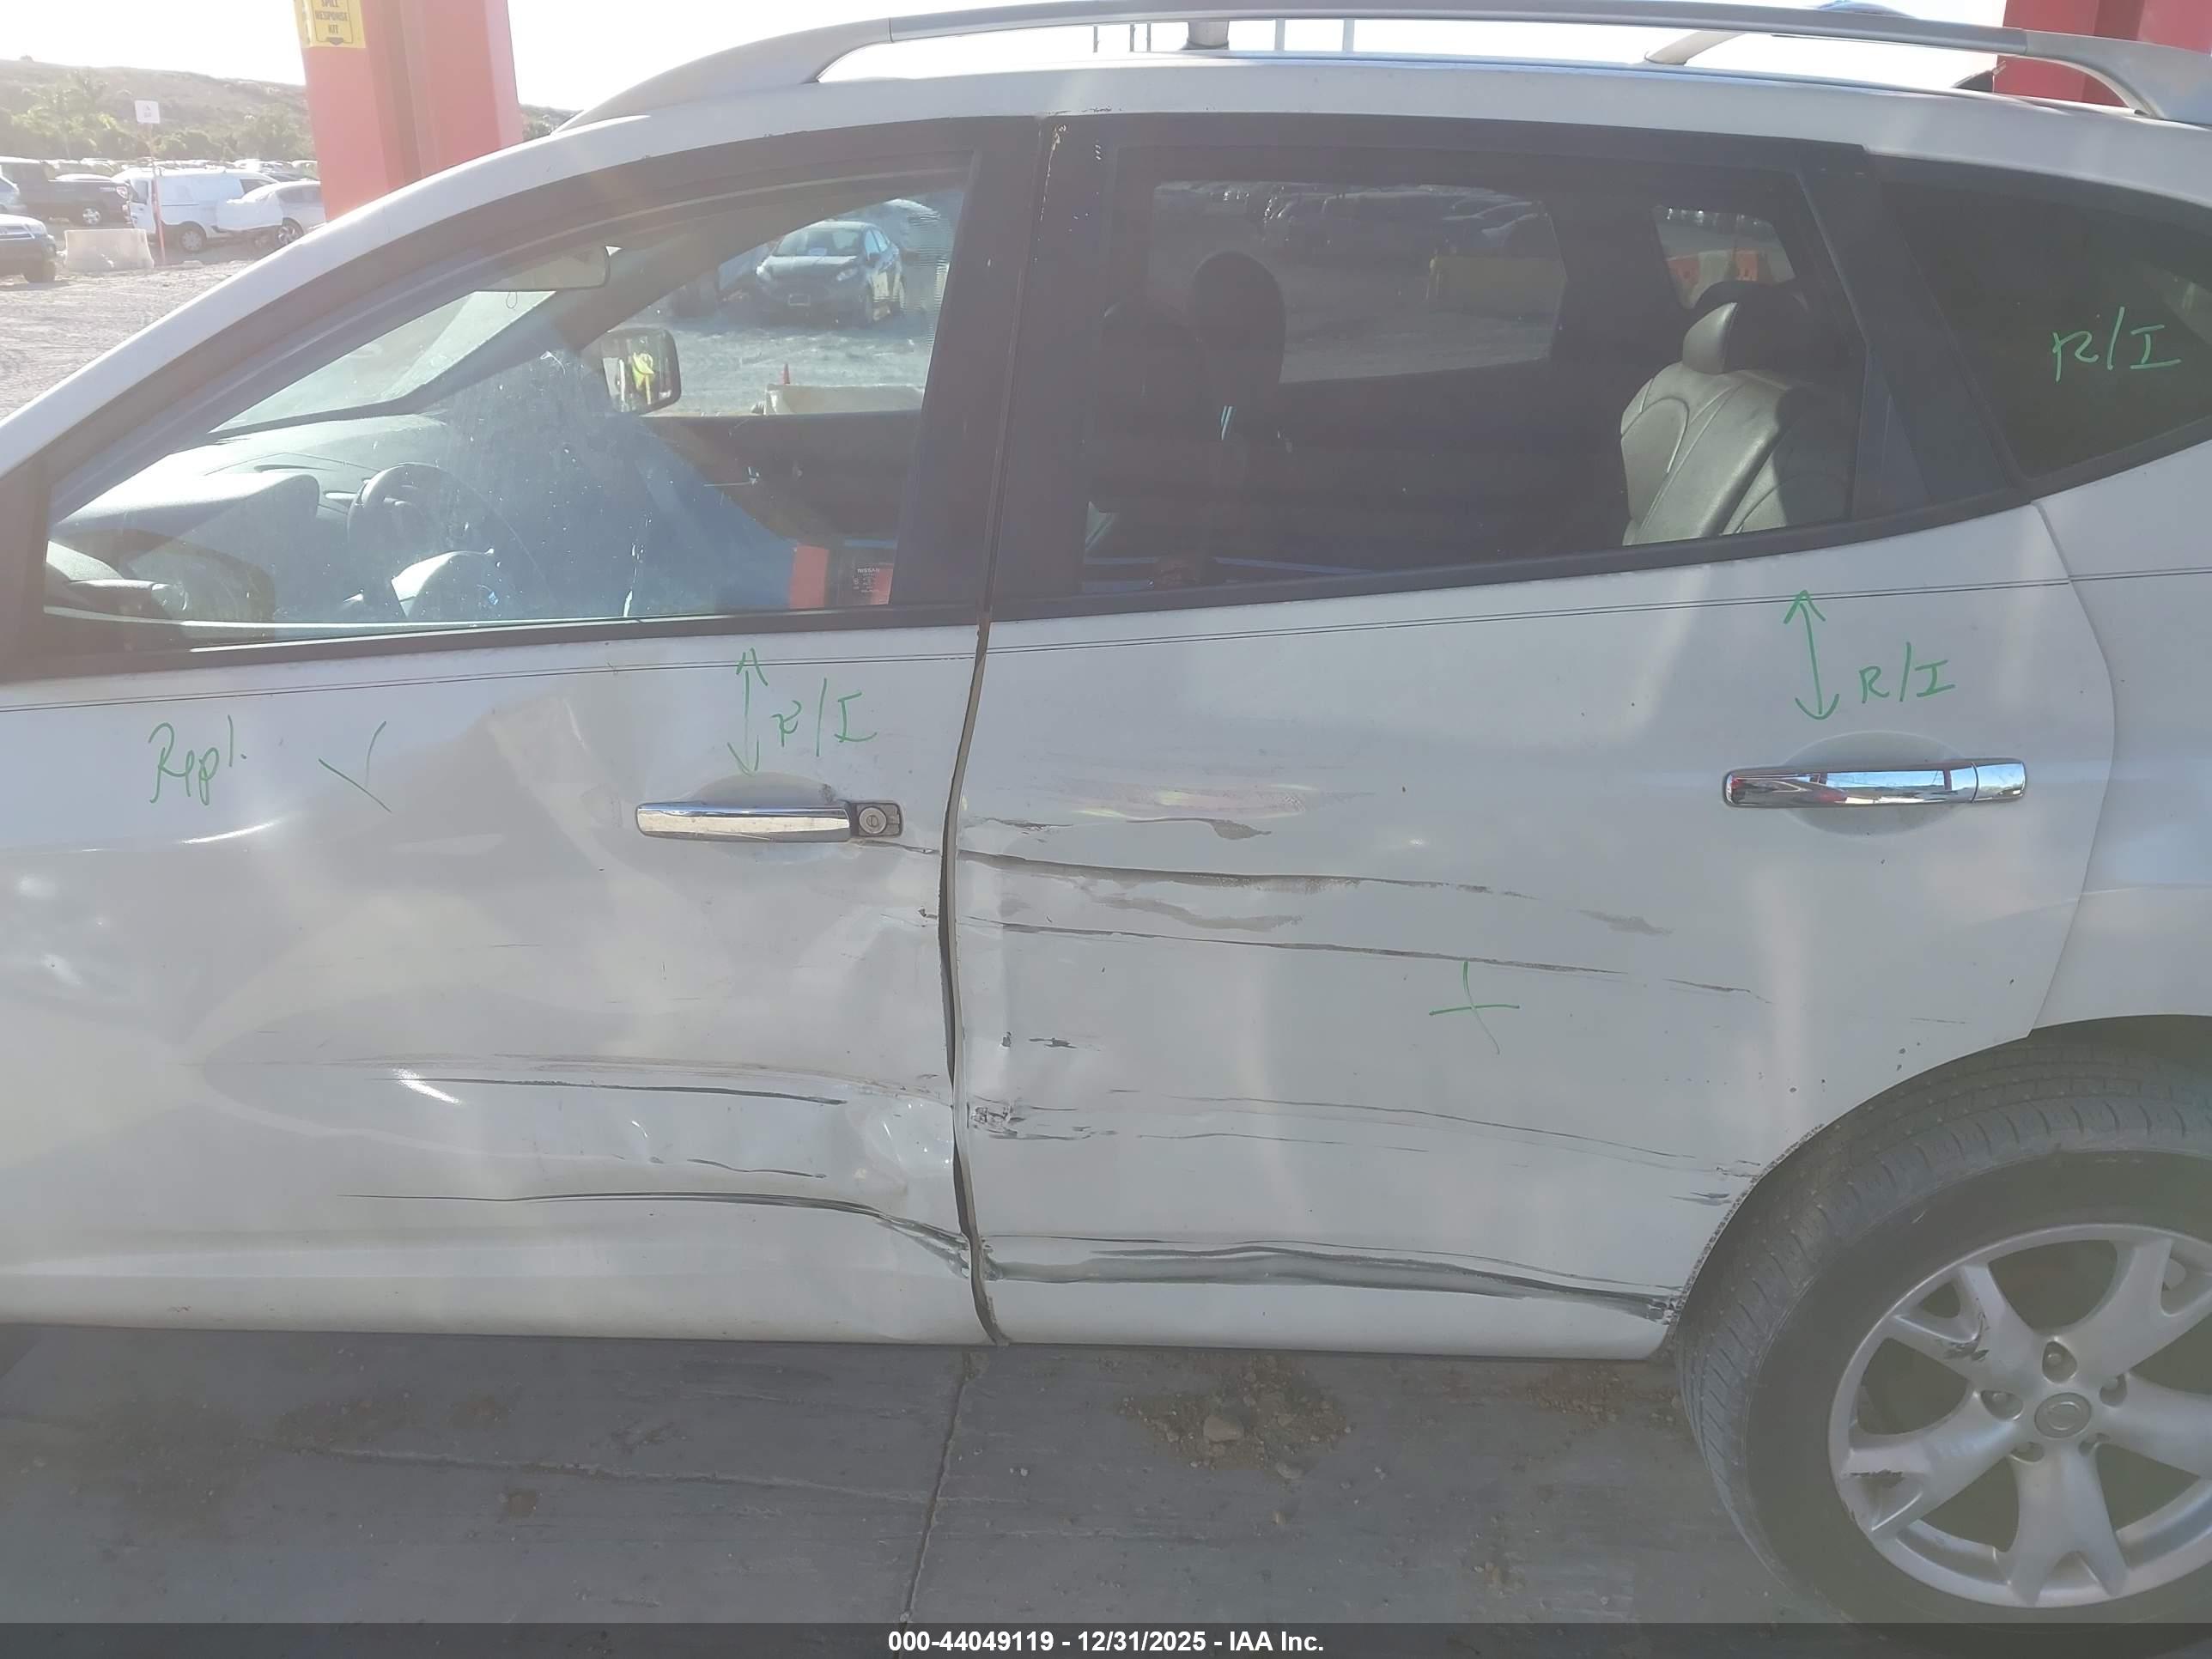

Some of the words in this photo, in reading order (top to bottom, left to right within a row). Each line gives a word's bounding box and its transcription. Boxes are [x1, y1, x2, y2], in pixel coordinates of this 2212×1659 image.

[315, 10, 348, 21] RESPONSE
[328, 24, 338, 34] KIT
[2052, 306, 2182, 382] R/I
[1858, 641, 1955, 704] R/I
